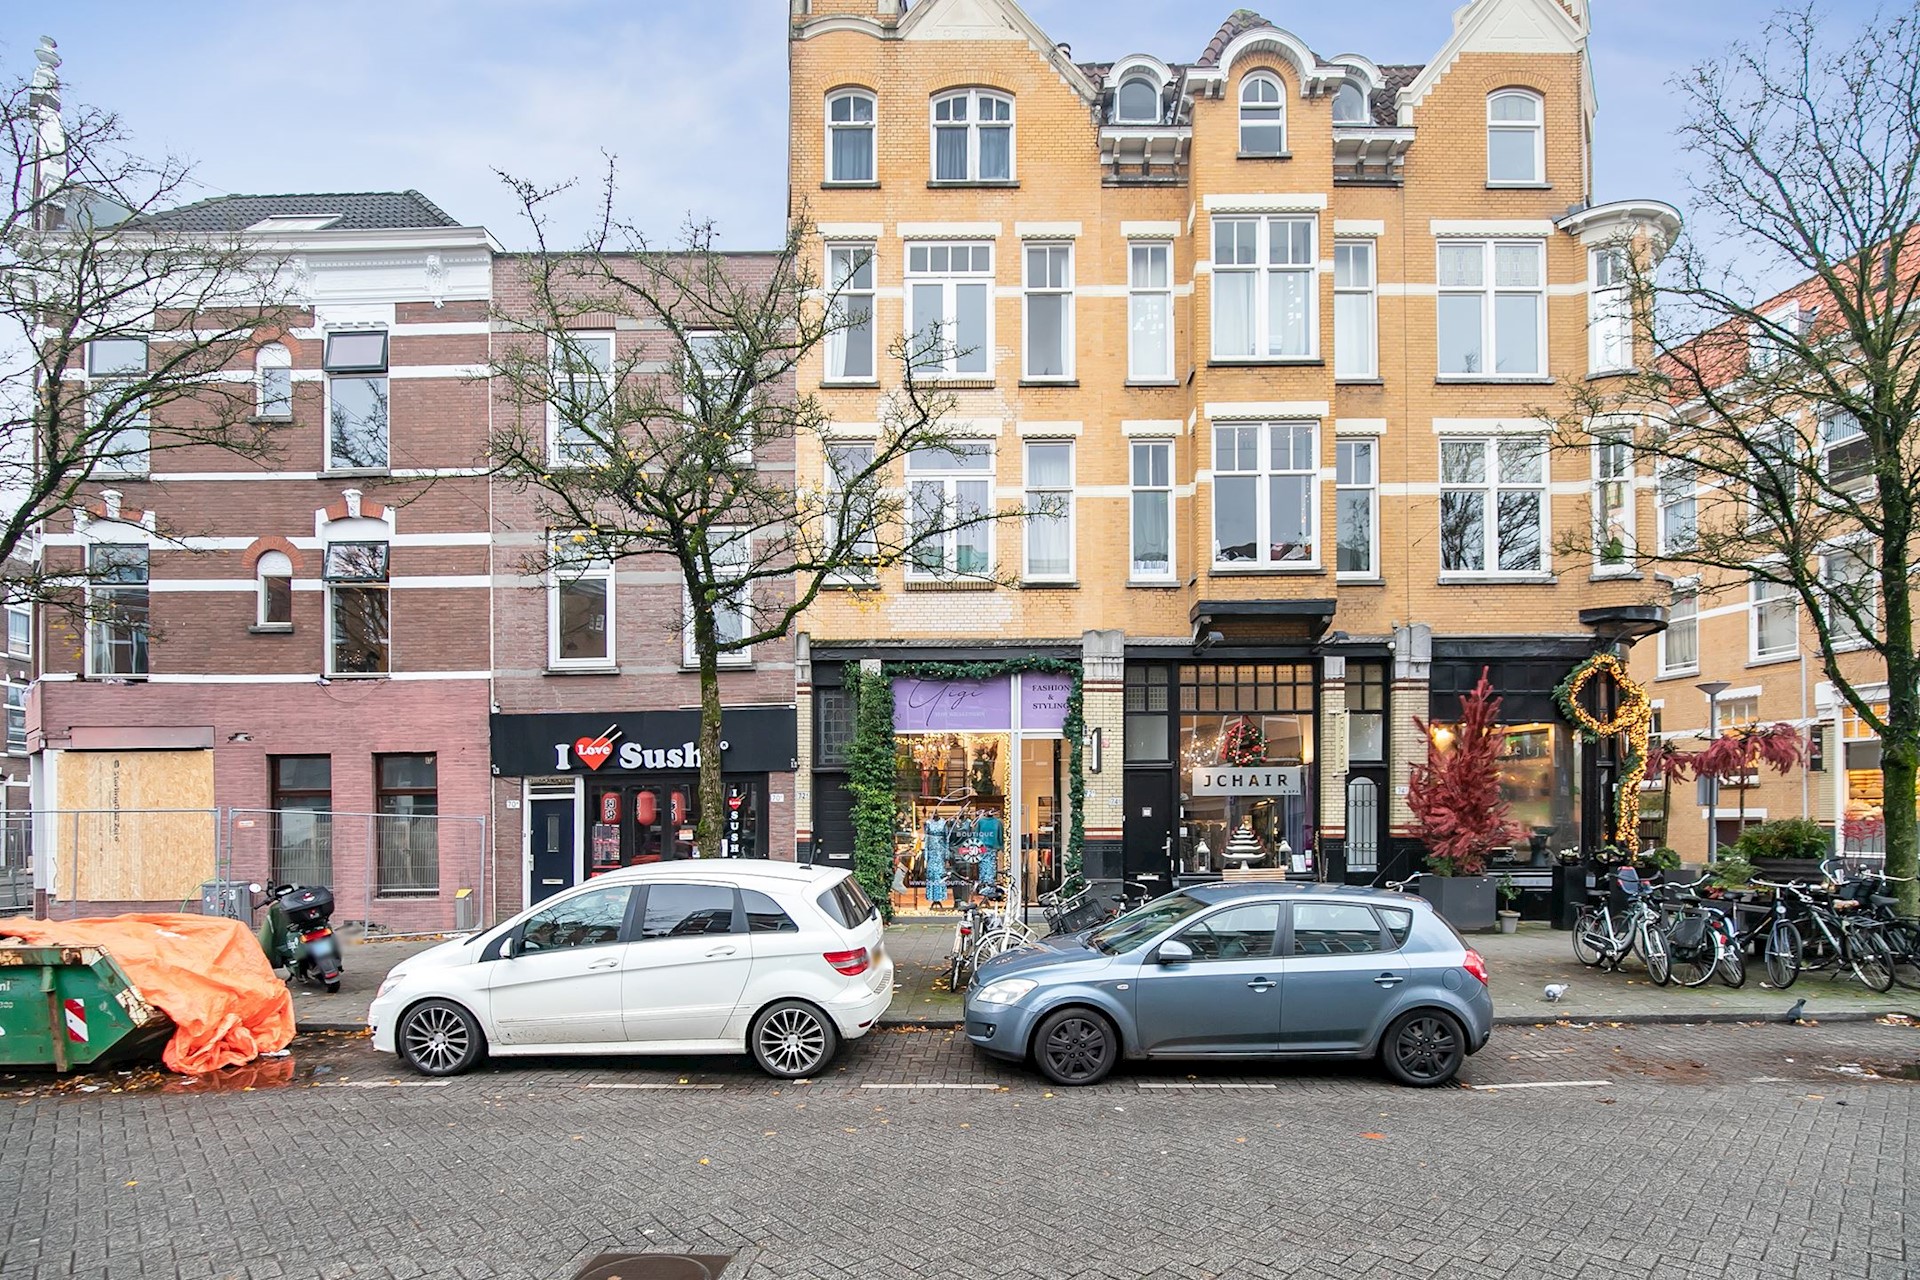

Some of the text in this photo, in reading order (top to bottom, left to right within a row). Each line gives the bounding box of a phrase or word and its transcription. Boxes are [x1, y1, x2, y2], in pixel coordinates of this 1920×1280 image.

[1032, 684, 1071, 692] FASHION
[908, 679, 984, 727] Gigi
[1032, 702, 1069, 710] STYLING
[555, 741, 702, 771] I Love Sush
[1203, 774, 1289, 788] JCHAIR
[730, 788, 738, 797] I
[729, 810, 740, 859] SUSH
